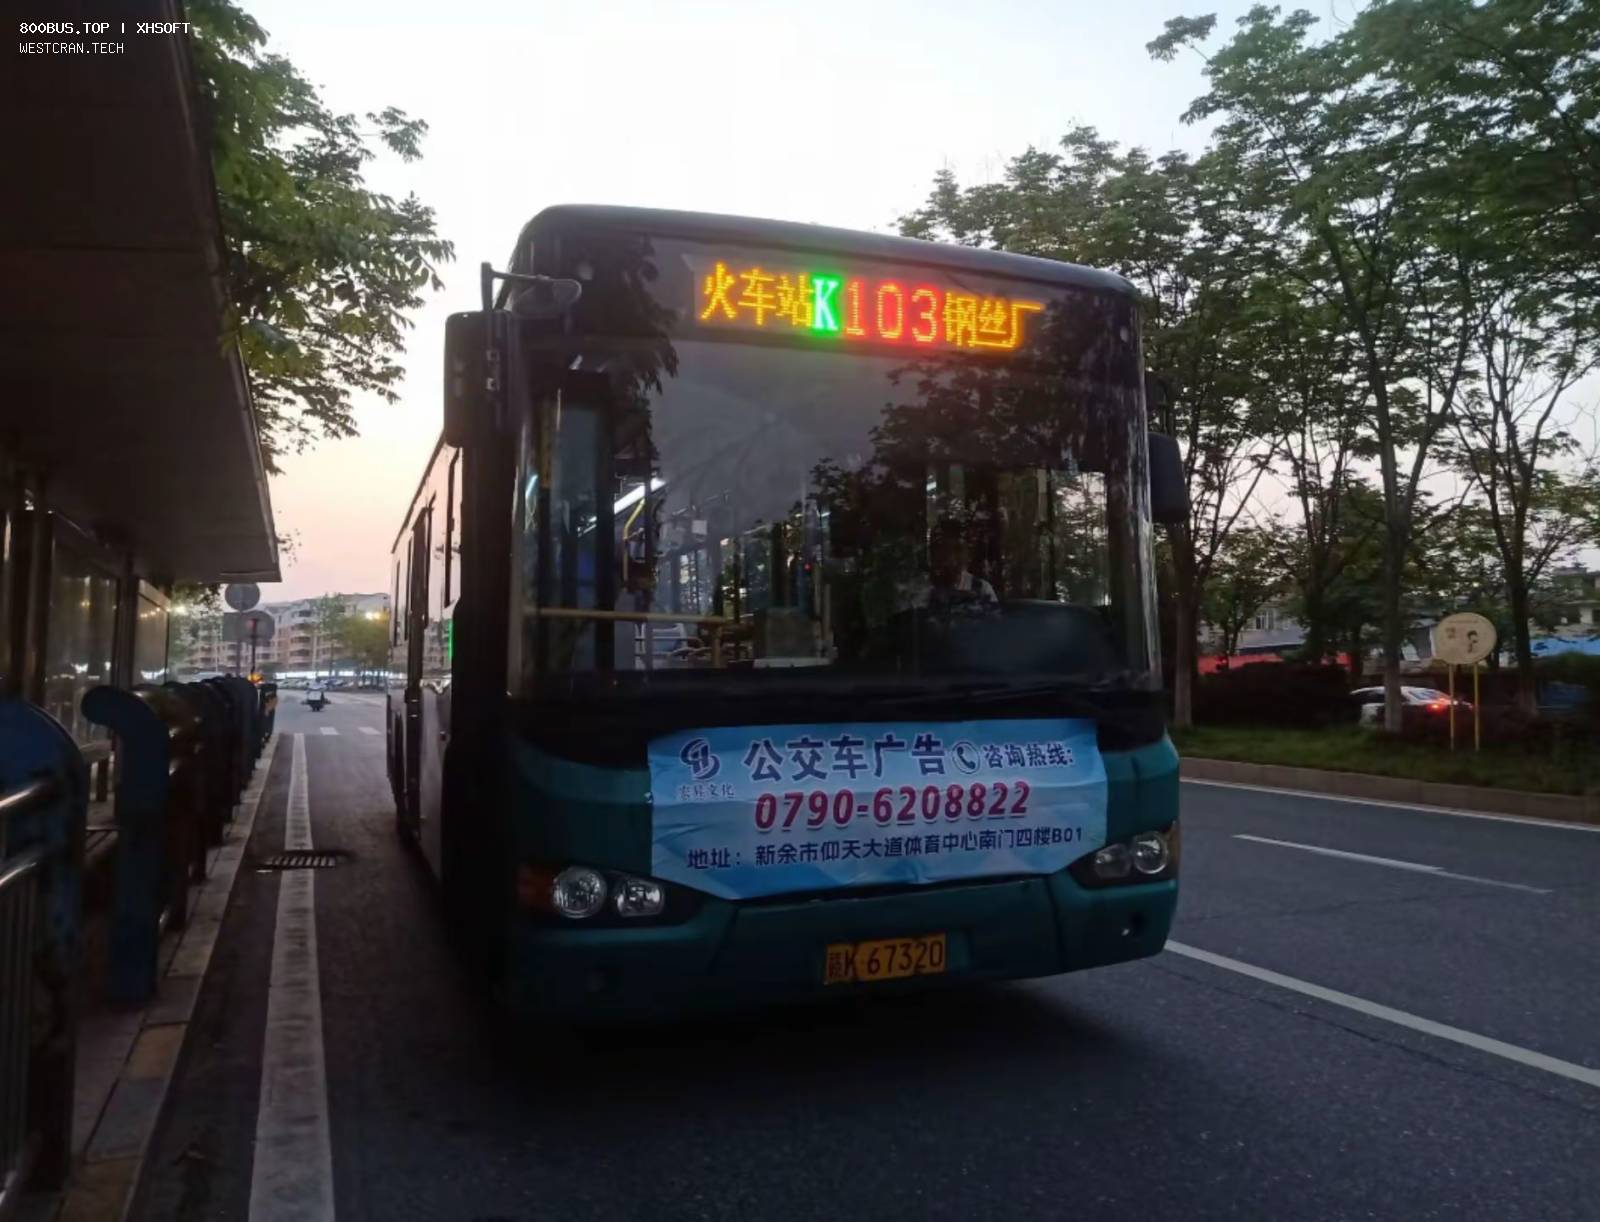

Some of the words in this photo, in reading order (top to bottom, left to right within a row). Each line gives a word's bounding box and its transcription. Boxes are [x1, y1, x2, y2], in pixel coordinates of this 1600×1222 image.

[743, 734, 946, 782] 公交车广告
[754, 781, 1031, 832] 0790-6208822
